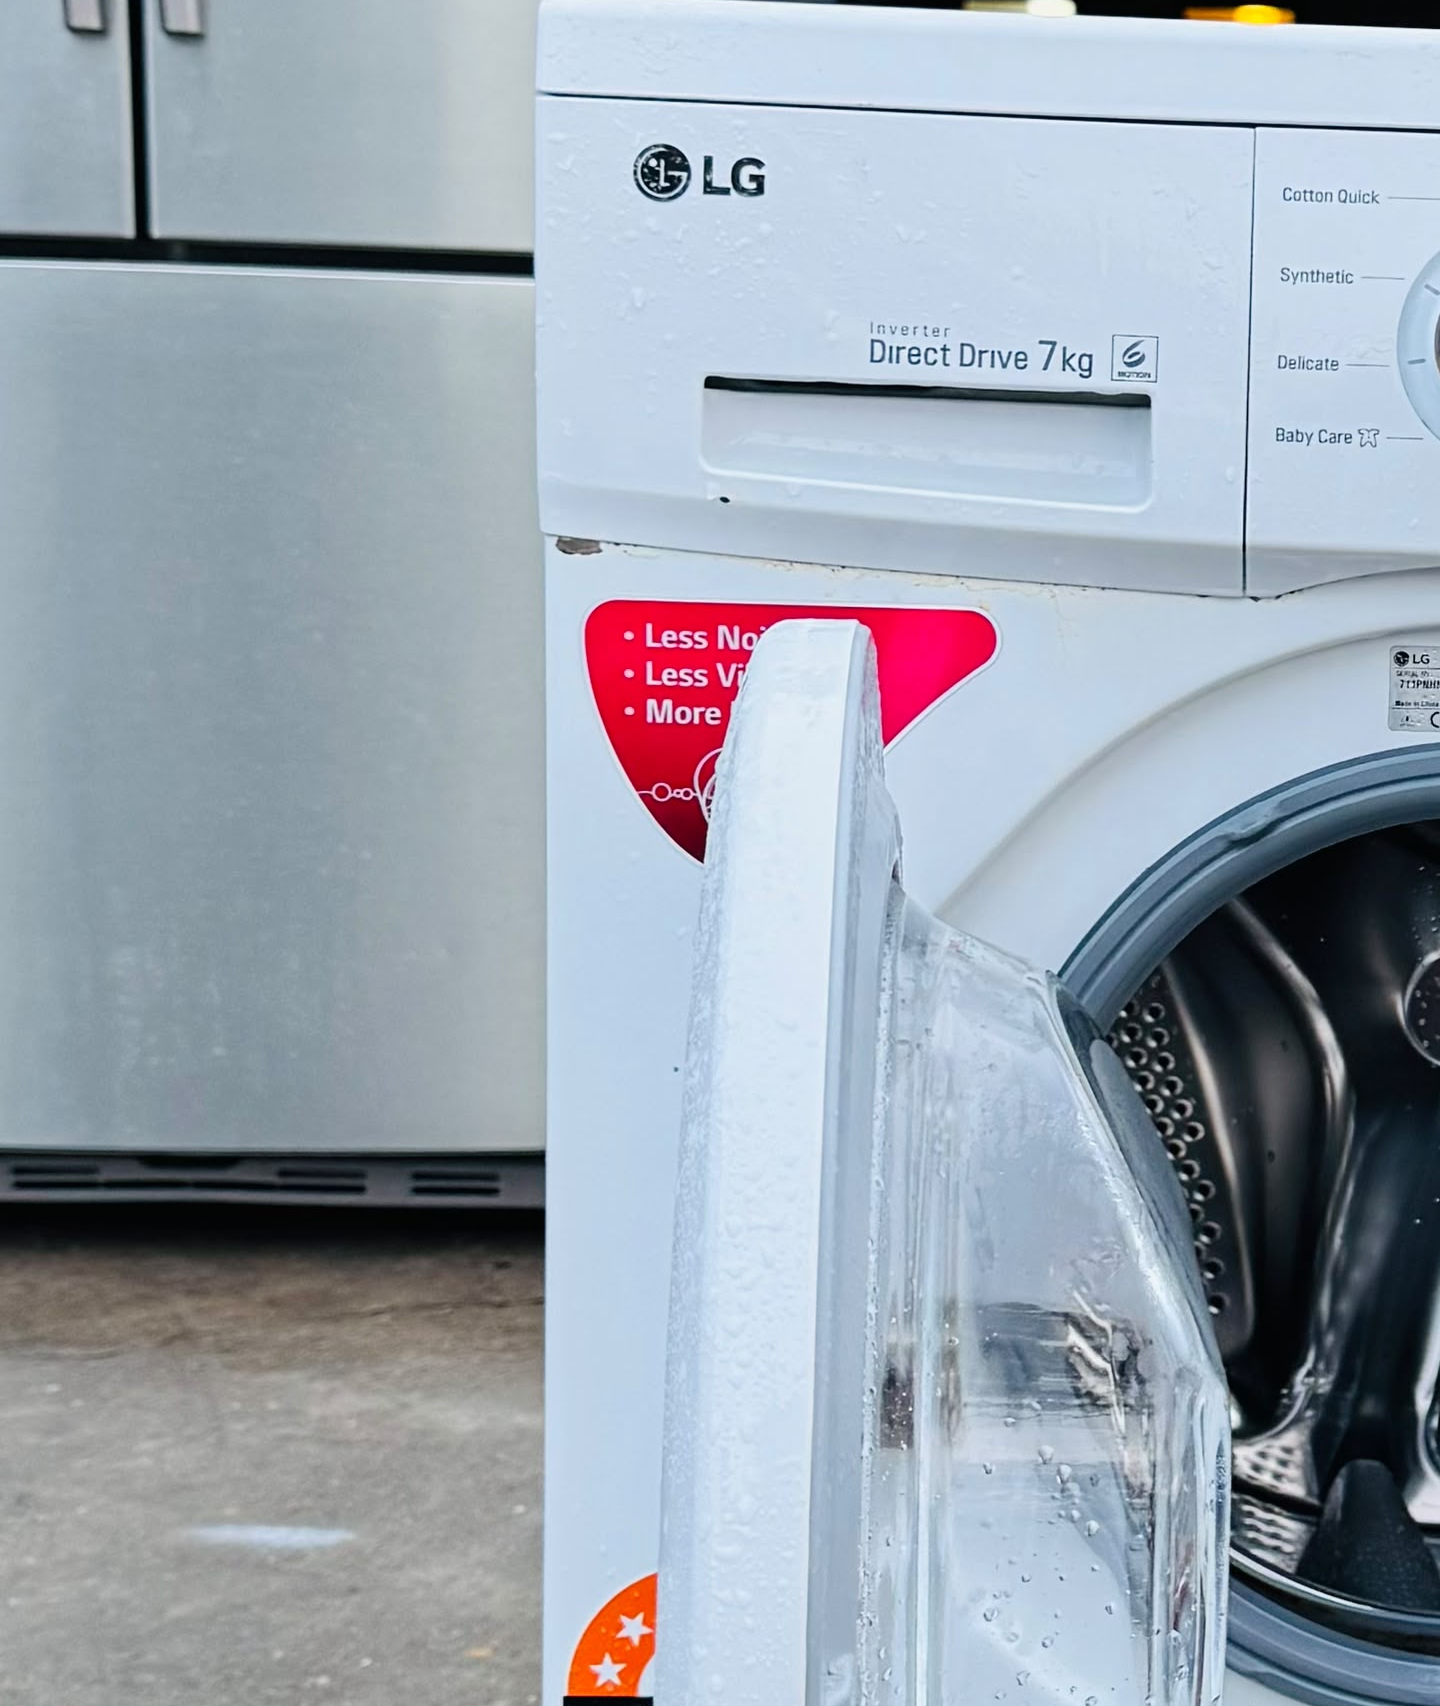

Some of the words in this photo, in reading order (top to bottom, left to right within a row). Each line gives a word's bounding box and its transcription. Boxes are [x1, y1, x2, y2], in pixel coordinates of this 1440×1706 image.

[702, 155, 766, 197] LG
[1282, 187, 1333, 204] Cotton
[1337, 188, 1380, 206] Quick
[1280, 267, 1355, 287] Synthetic
[869, 321, 951, 338] Inverter
[869, 338, 951, 368] Direct
[958, 341, 1029, 371] Drive
[1277, 355, 1339, 372] Delicate
[1275, 428, 1313, 447] Baby
[1317, 428, 1353, 445] Care
[645, 622, 708, 649] Less
[1412, 654, 1430, 665] LG
[645, 660, 708, 687] Less
[645, 698, 722, 725] More
